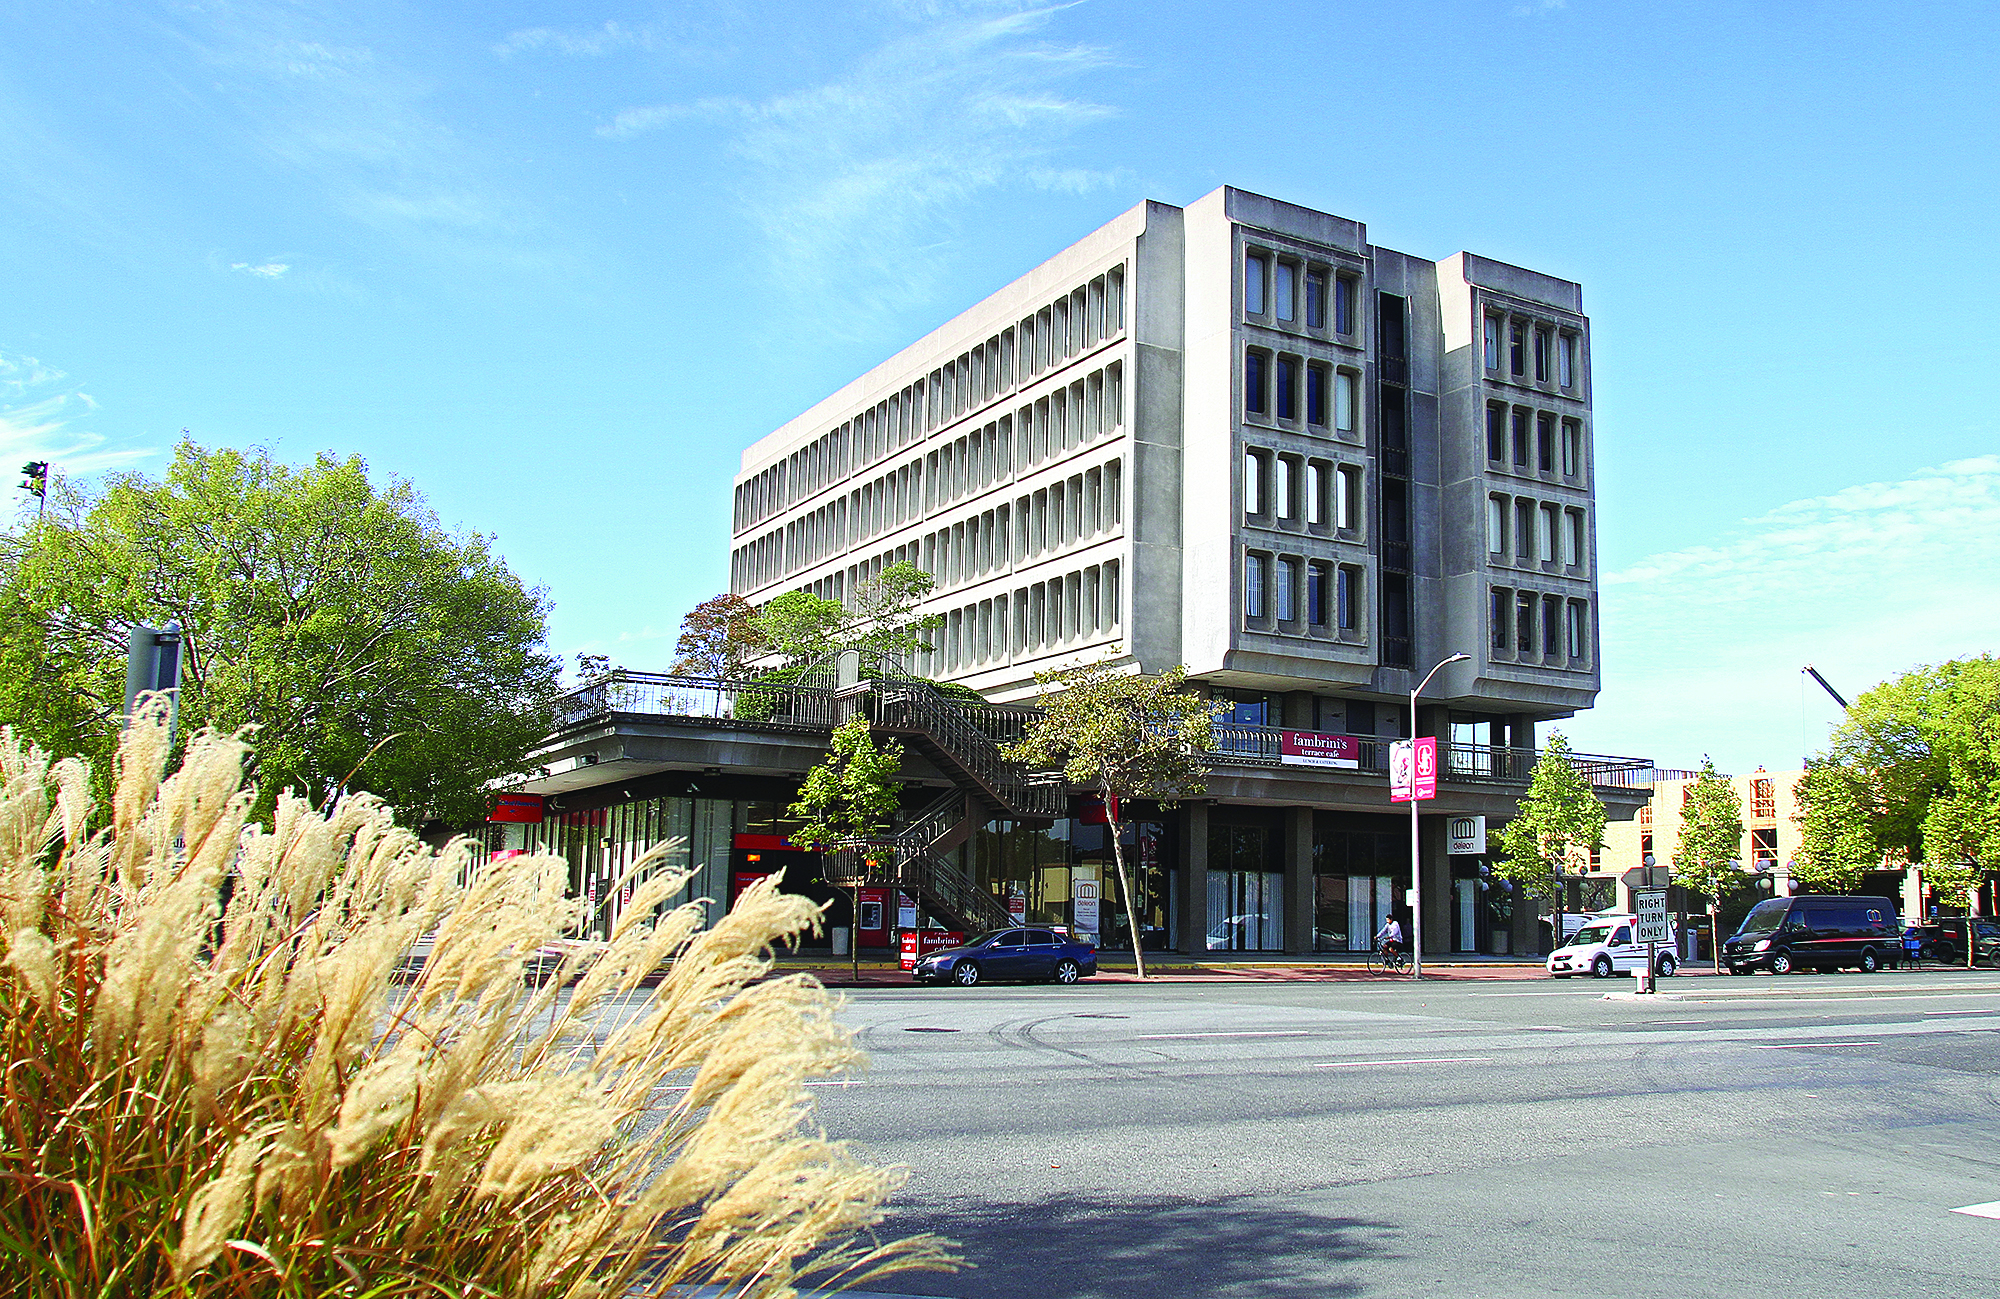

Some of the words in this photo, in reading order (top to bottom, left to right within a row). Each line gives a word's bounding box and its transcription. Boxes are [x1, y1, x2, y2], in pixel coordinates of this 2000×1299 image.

[1293, 733, 1348, 750] fambrini's
[1301, 748, 1325, 757] terrace
[1325, 750, 1340, 758] cafe
[1639, 898, 1665, 909] RIGHT
[1640, 912, 1663, 923] TURN
[1641, 926, 1663, 937] ONLY
[923, 936, 960, 944] fambrini's
